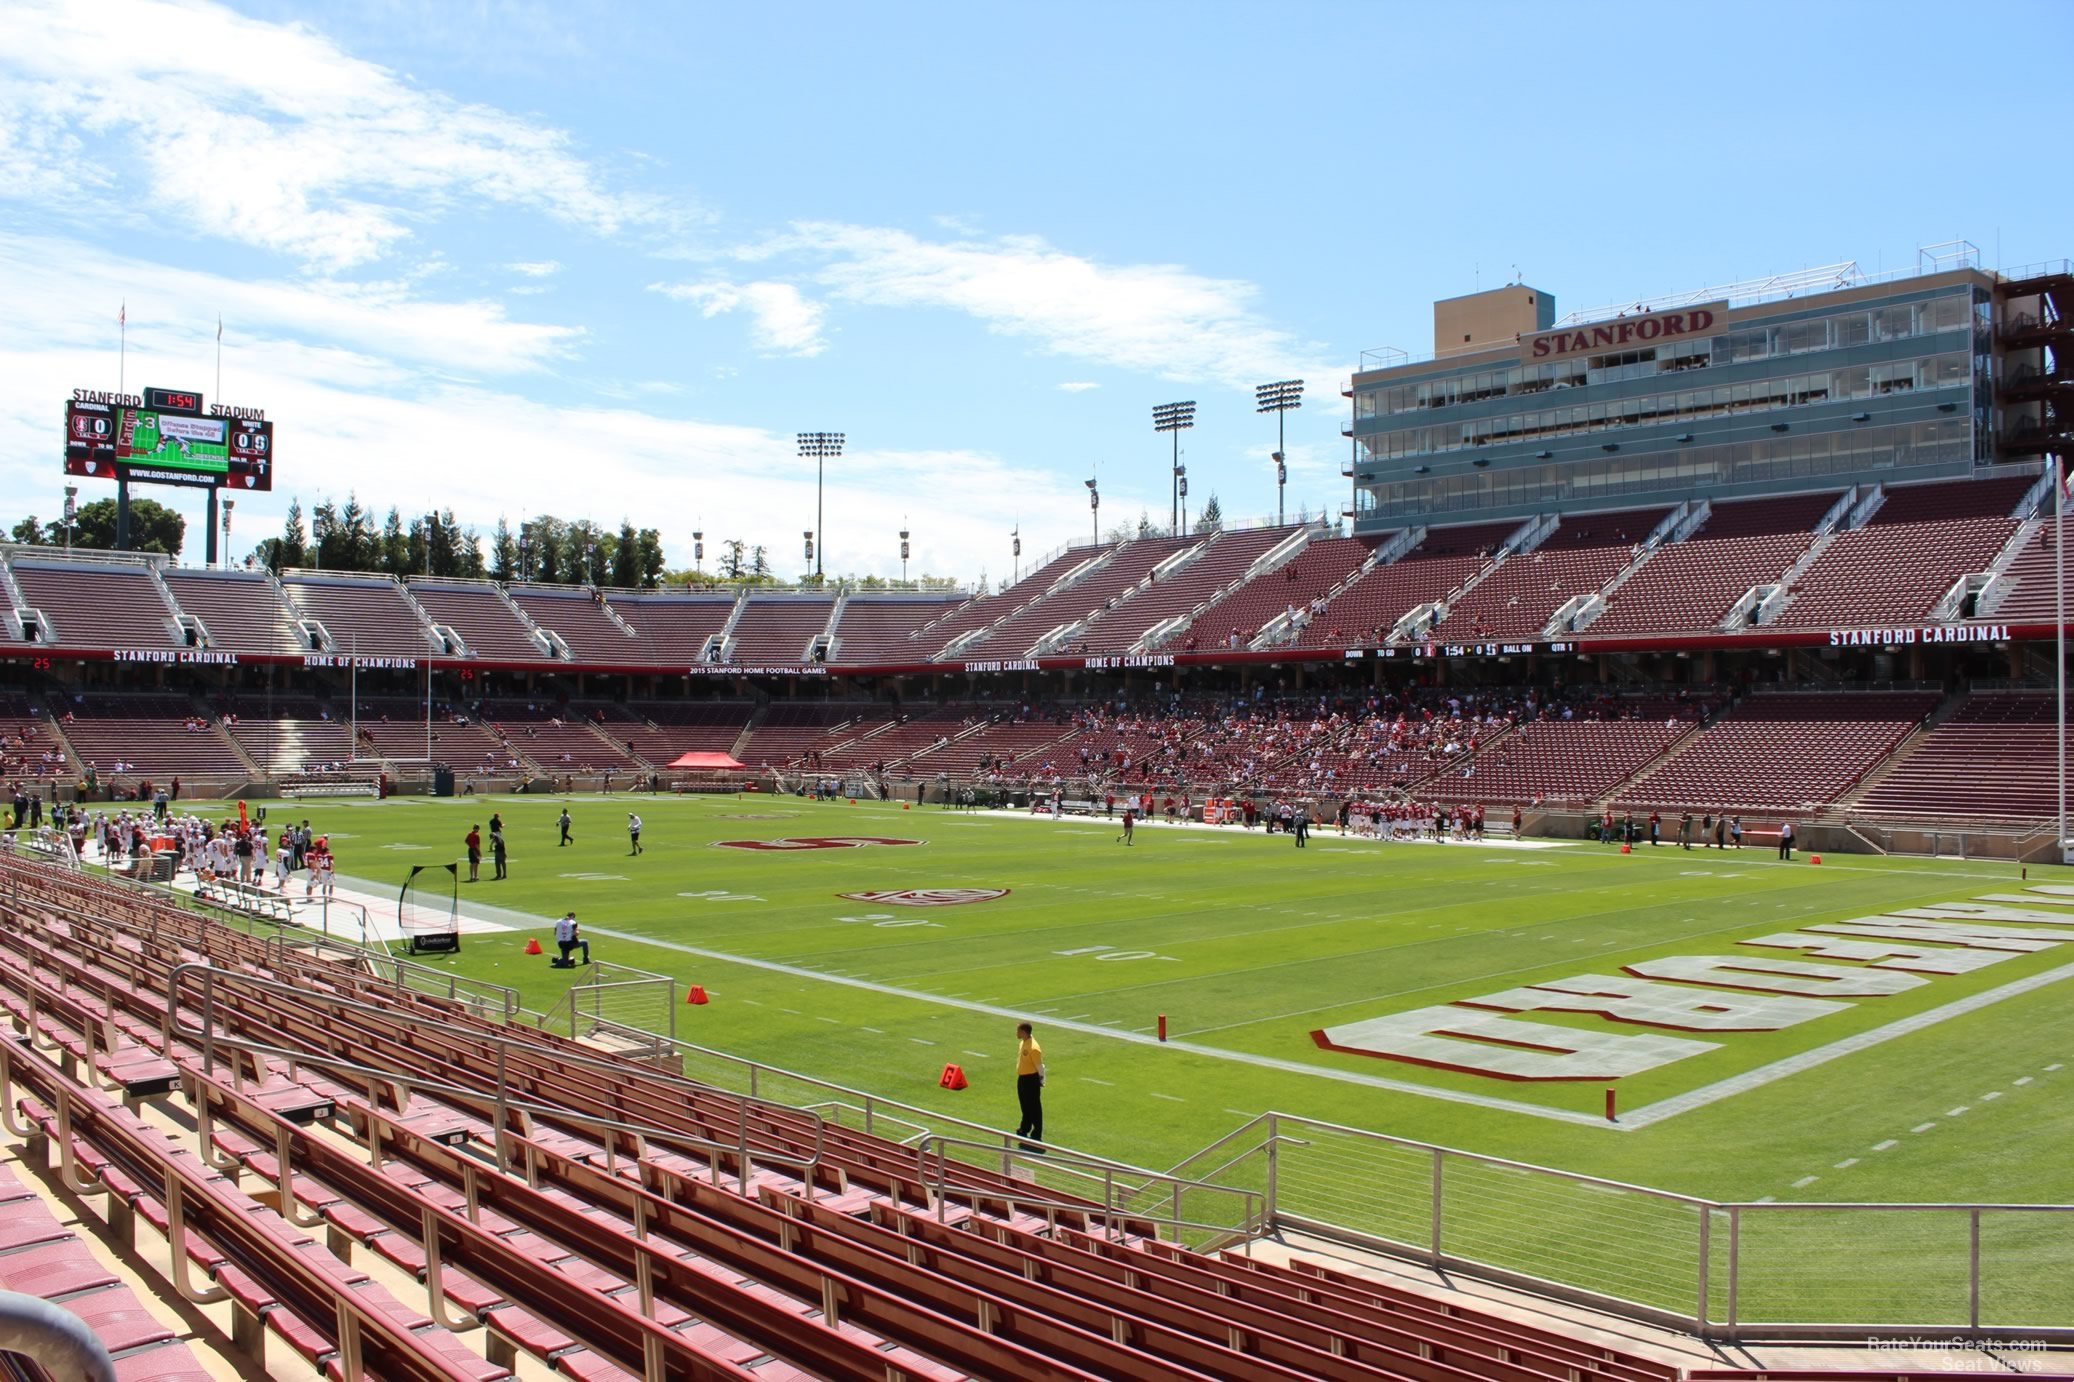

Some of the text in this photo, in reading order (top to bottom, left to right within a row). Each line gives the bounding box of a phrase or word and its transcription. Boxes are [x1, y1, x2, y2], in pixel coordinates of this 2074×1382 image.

[1533, 310, 1714, 357] STANFORD
[73, 389, 141, 408] STANFORD
[167, 395, 193, 407] 1:54
[75, 402, 110, 412] CARDINAL
[210, 404, 265, 421] STADIUM
[95, 419, 105, 434] 0
[145, 417, 156, 429] 3
[242, 421, 261, 429] WHITE
[239, 434, 248, 448] 0
[259, 464, 264, 475] 1
[129, 469, 215, 484] WWW.GOSTANFORD.COM
[1830, 625, 2011, 647] STANFORD CARDINAL
[1376, 649, 1395, 657] TO GO
[1415, 648, 1421, 657] 0
[1444, 646, 1465, 656] 1:54
[1476, 646, 1482, 655] 0
[1503, 644, 1532, 654] BALL ON
[1551, 643, 1573, 653] QTR 1
[113, 650, 238, 665] STANFORD CARDINAL
[1345, 650, 1364, 659] DOWN
[34, 657, 50, 669] 25
[303, 656, 416, 669] HOME OF CHAMPIONS
[964, 660, 1040, 672] STANFORD CARDINAL
[1085, 655, 1175, 668] HOME OF CHAMPIONS
[689, 667, 827, 675] 2015 STANFORD HOME FOOTBALL GAMES
[833, 914, 930, 928] 20
[1053, 945, 1157, 962] 10
[943, 1066, 955, 1085] G
